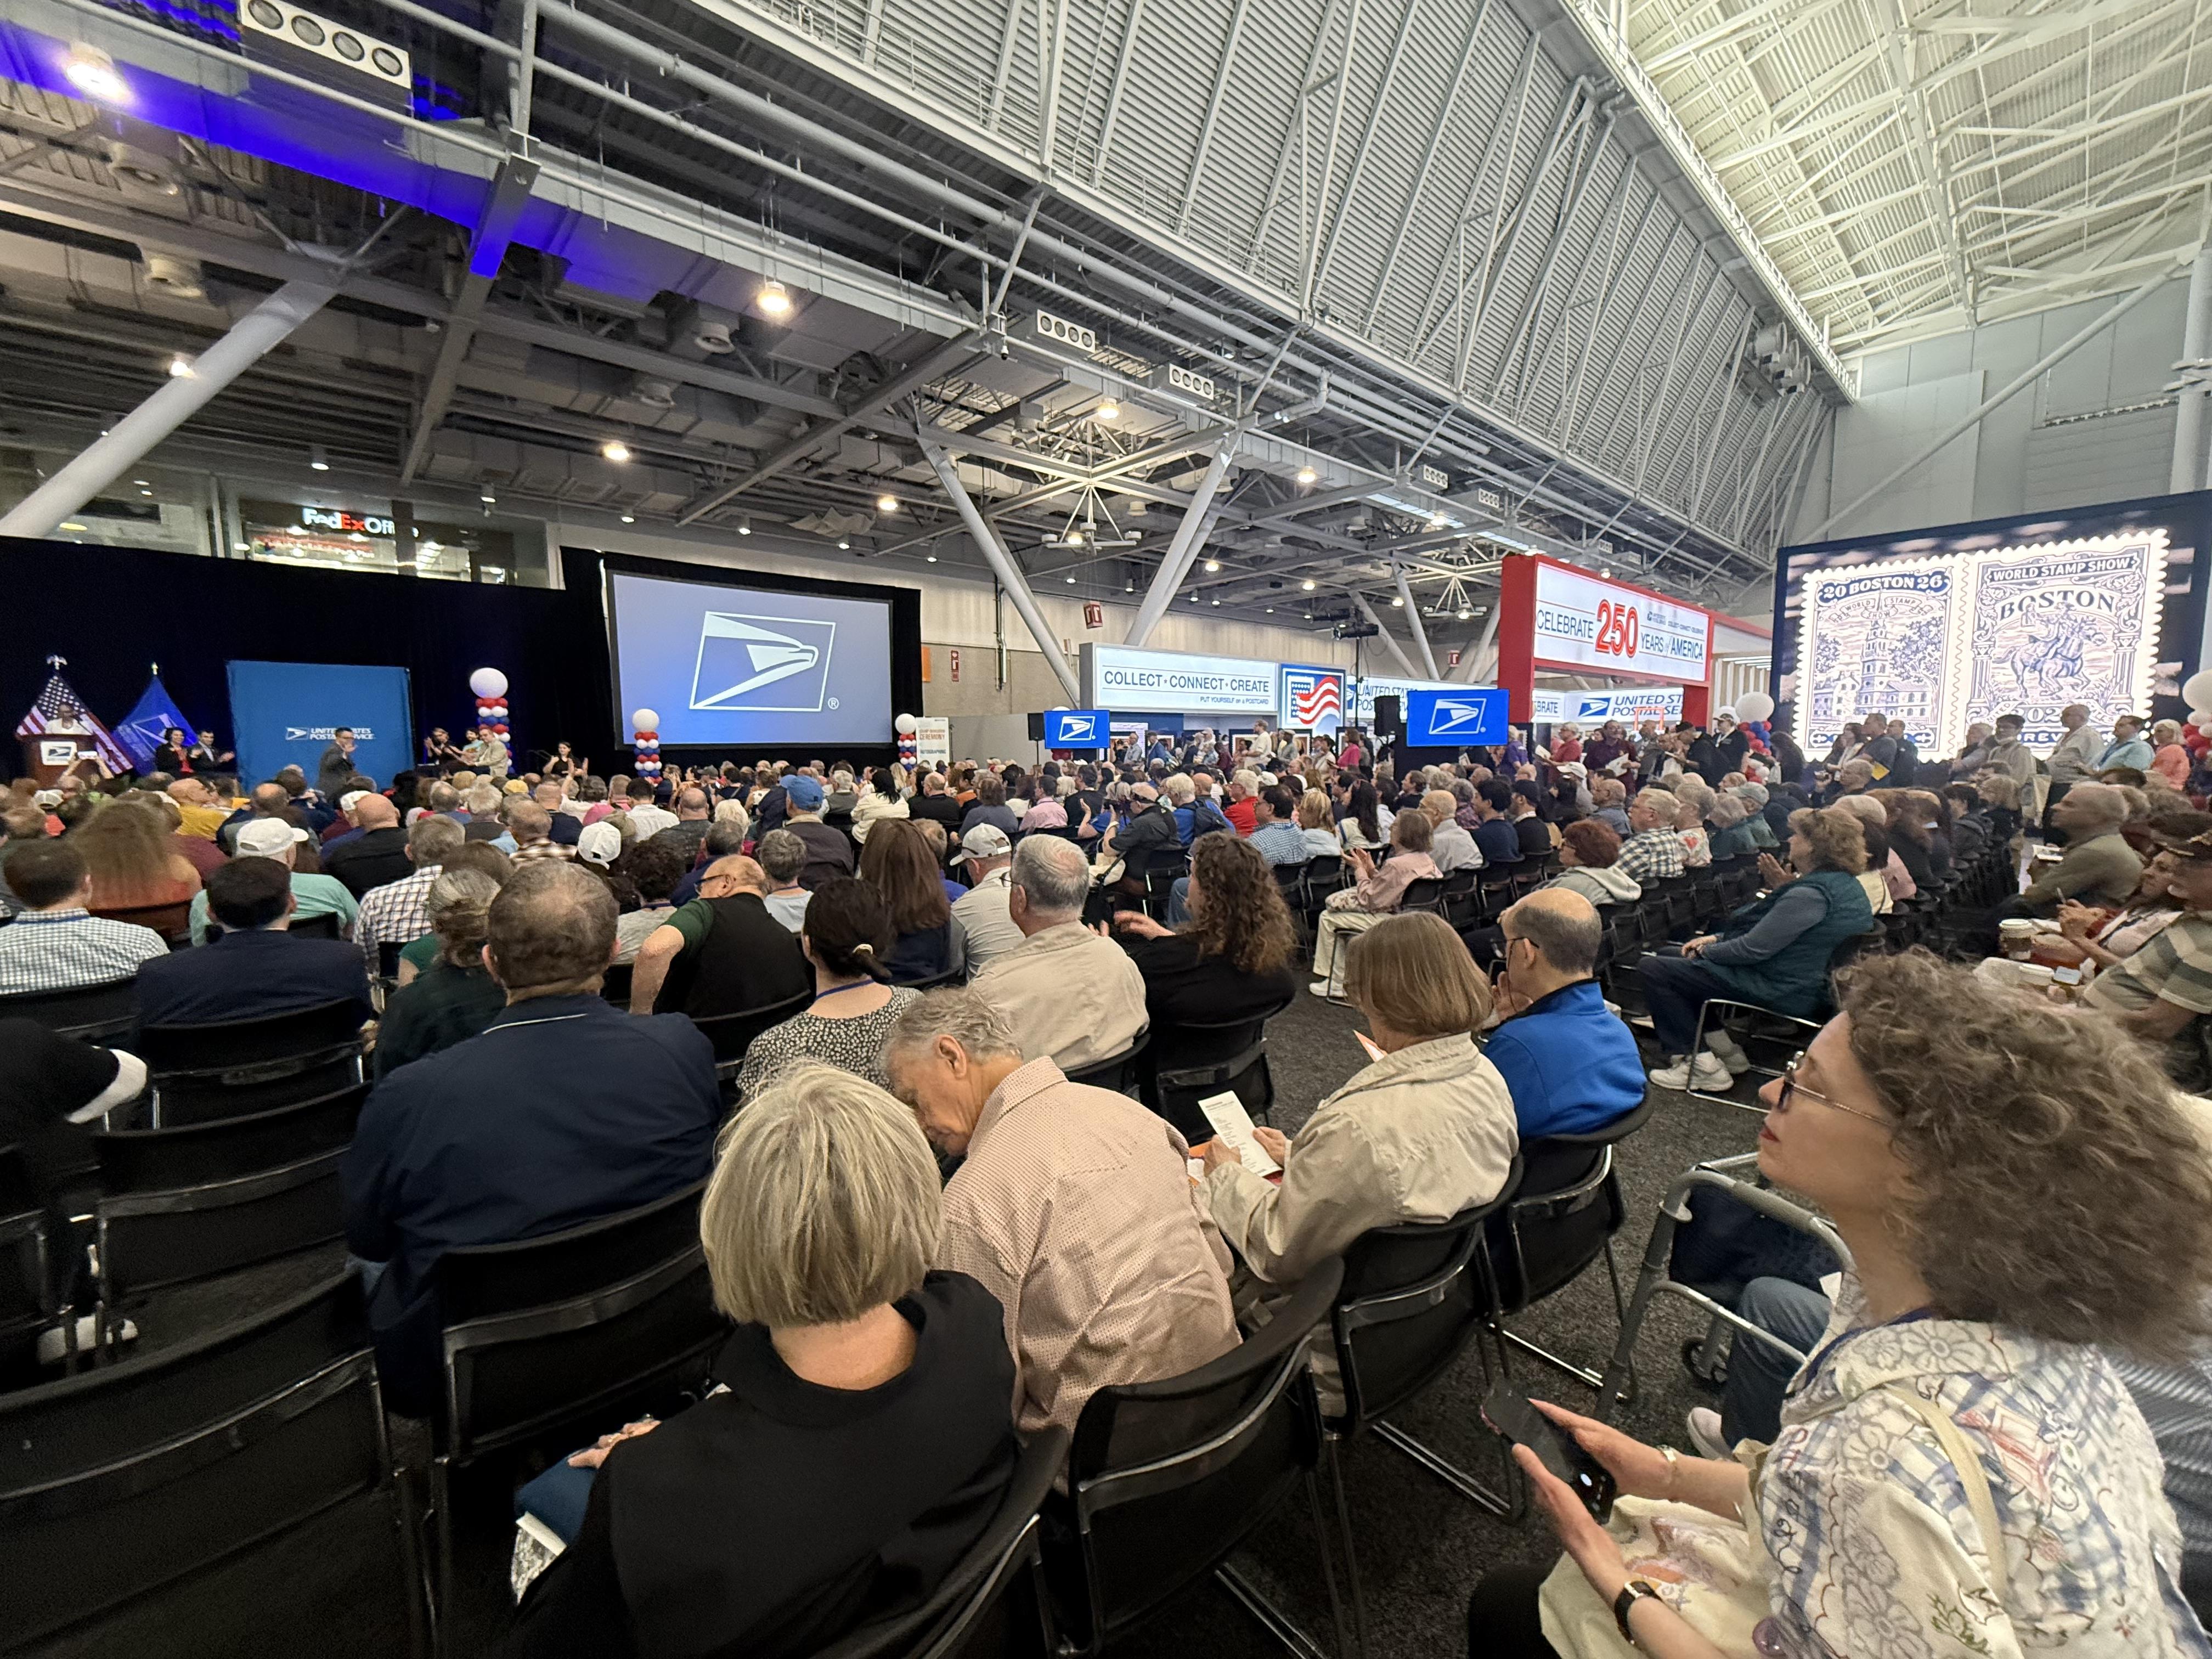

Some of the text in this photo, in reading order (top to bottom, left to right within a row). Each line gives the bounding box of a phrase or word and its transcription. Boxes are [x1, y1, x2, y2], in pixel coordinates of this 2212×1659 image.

[1993, 557, 2130, 581] WORLD STAMP SHOW
[1823, 574, 1943, 599] 20 BOSTON 26
[1844, 600, 1871, 611] WORLD
[1867, 611, 1891, 619] SHOW
[2000, 590, 2114, 620] BOSTON
[1537, 610, 1594, 639] CELEBRATE
[1595, 599, 1639, 658] 250
[1641, 632, 1664, 653] YEARS
[1671, 636, 1703, 661] AMERICA
[1104, 671, 1269, 692] COLLECT CONNECT CREATE
[1534, 701, 1558, 713] BRATE
[1615, 694, 1682, 706] UNITED ST
